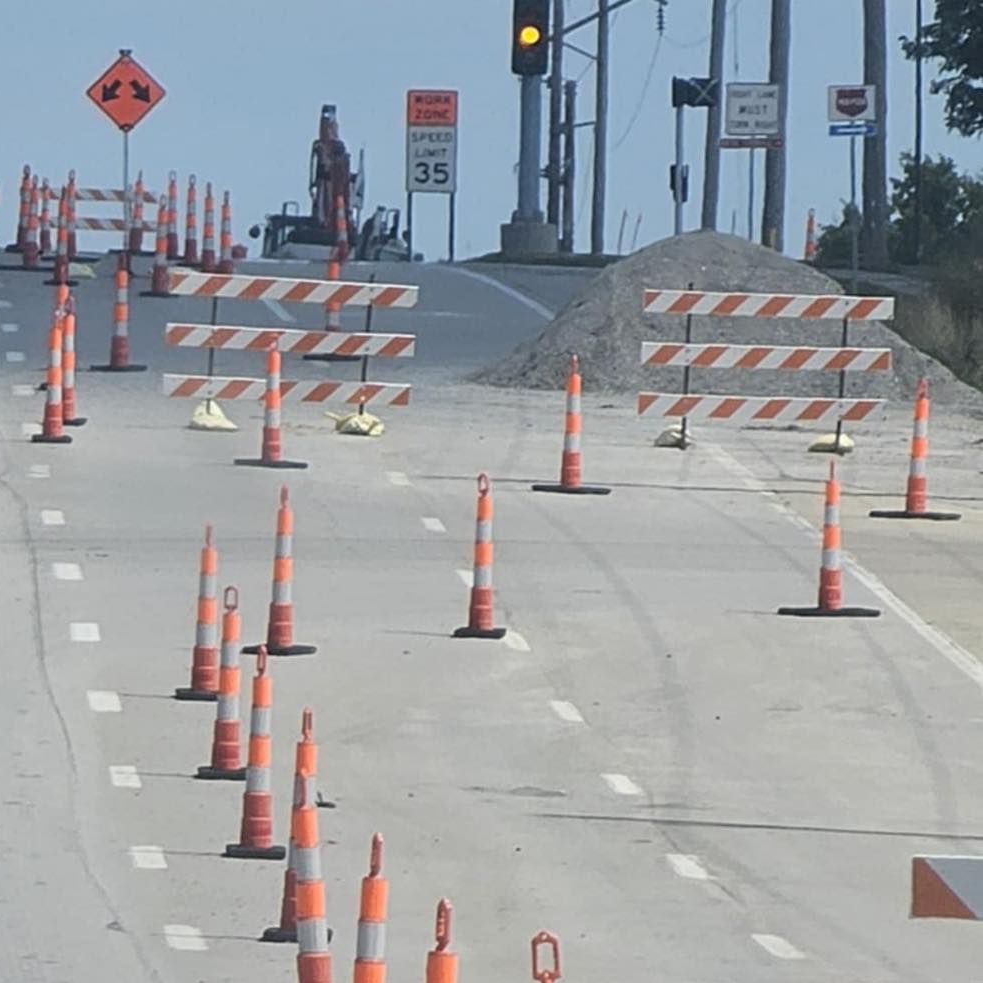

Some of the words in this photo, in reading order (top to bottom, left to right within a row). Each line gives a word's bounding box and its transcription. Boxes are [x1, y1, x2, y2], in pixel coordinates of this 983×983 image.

[414, 95, 451, 105] WORK
[414, 109, 450, 120] ZONE
[738, 104, 768, 115] MUST
[411, 131, 453, 143] SPEED
[414, 147, 448, 158] LIMIT
[414, 161, 449, 184] 35
